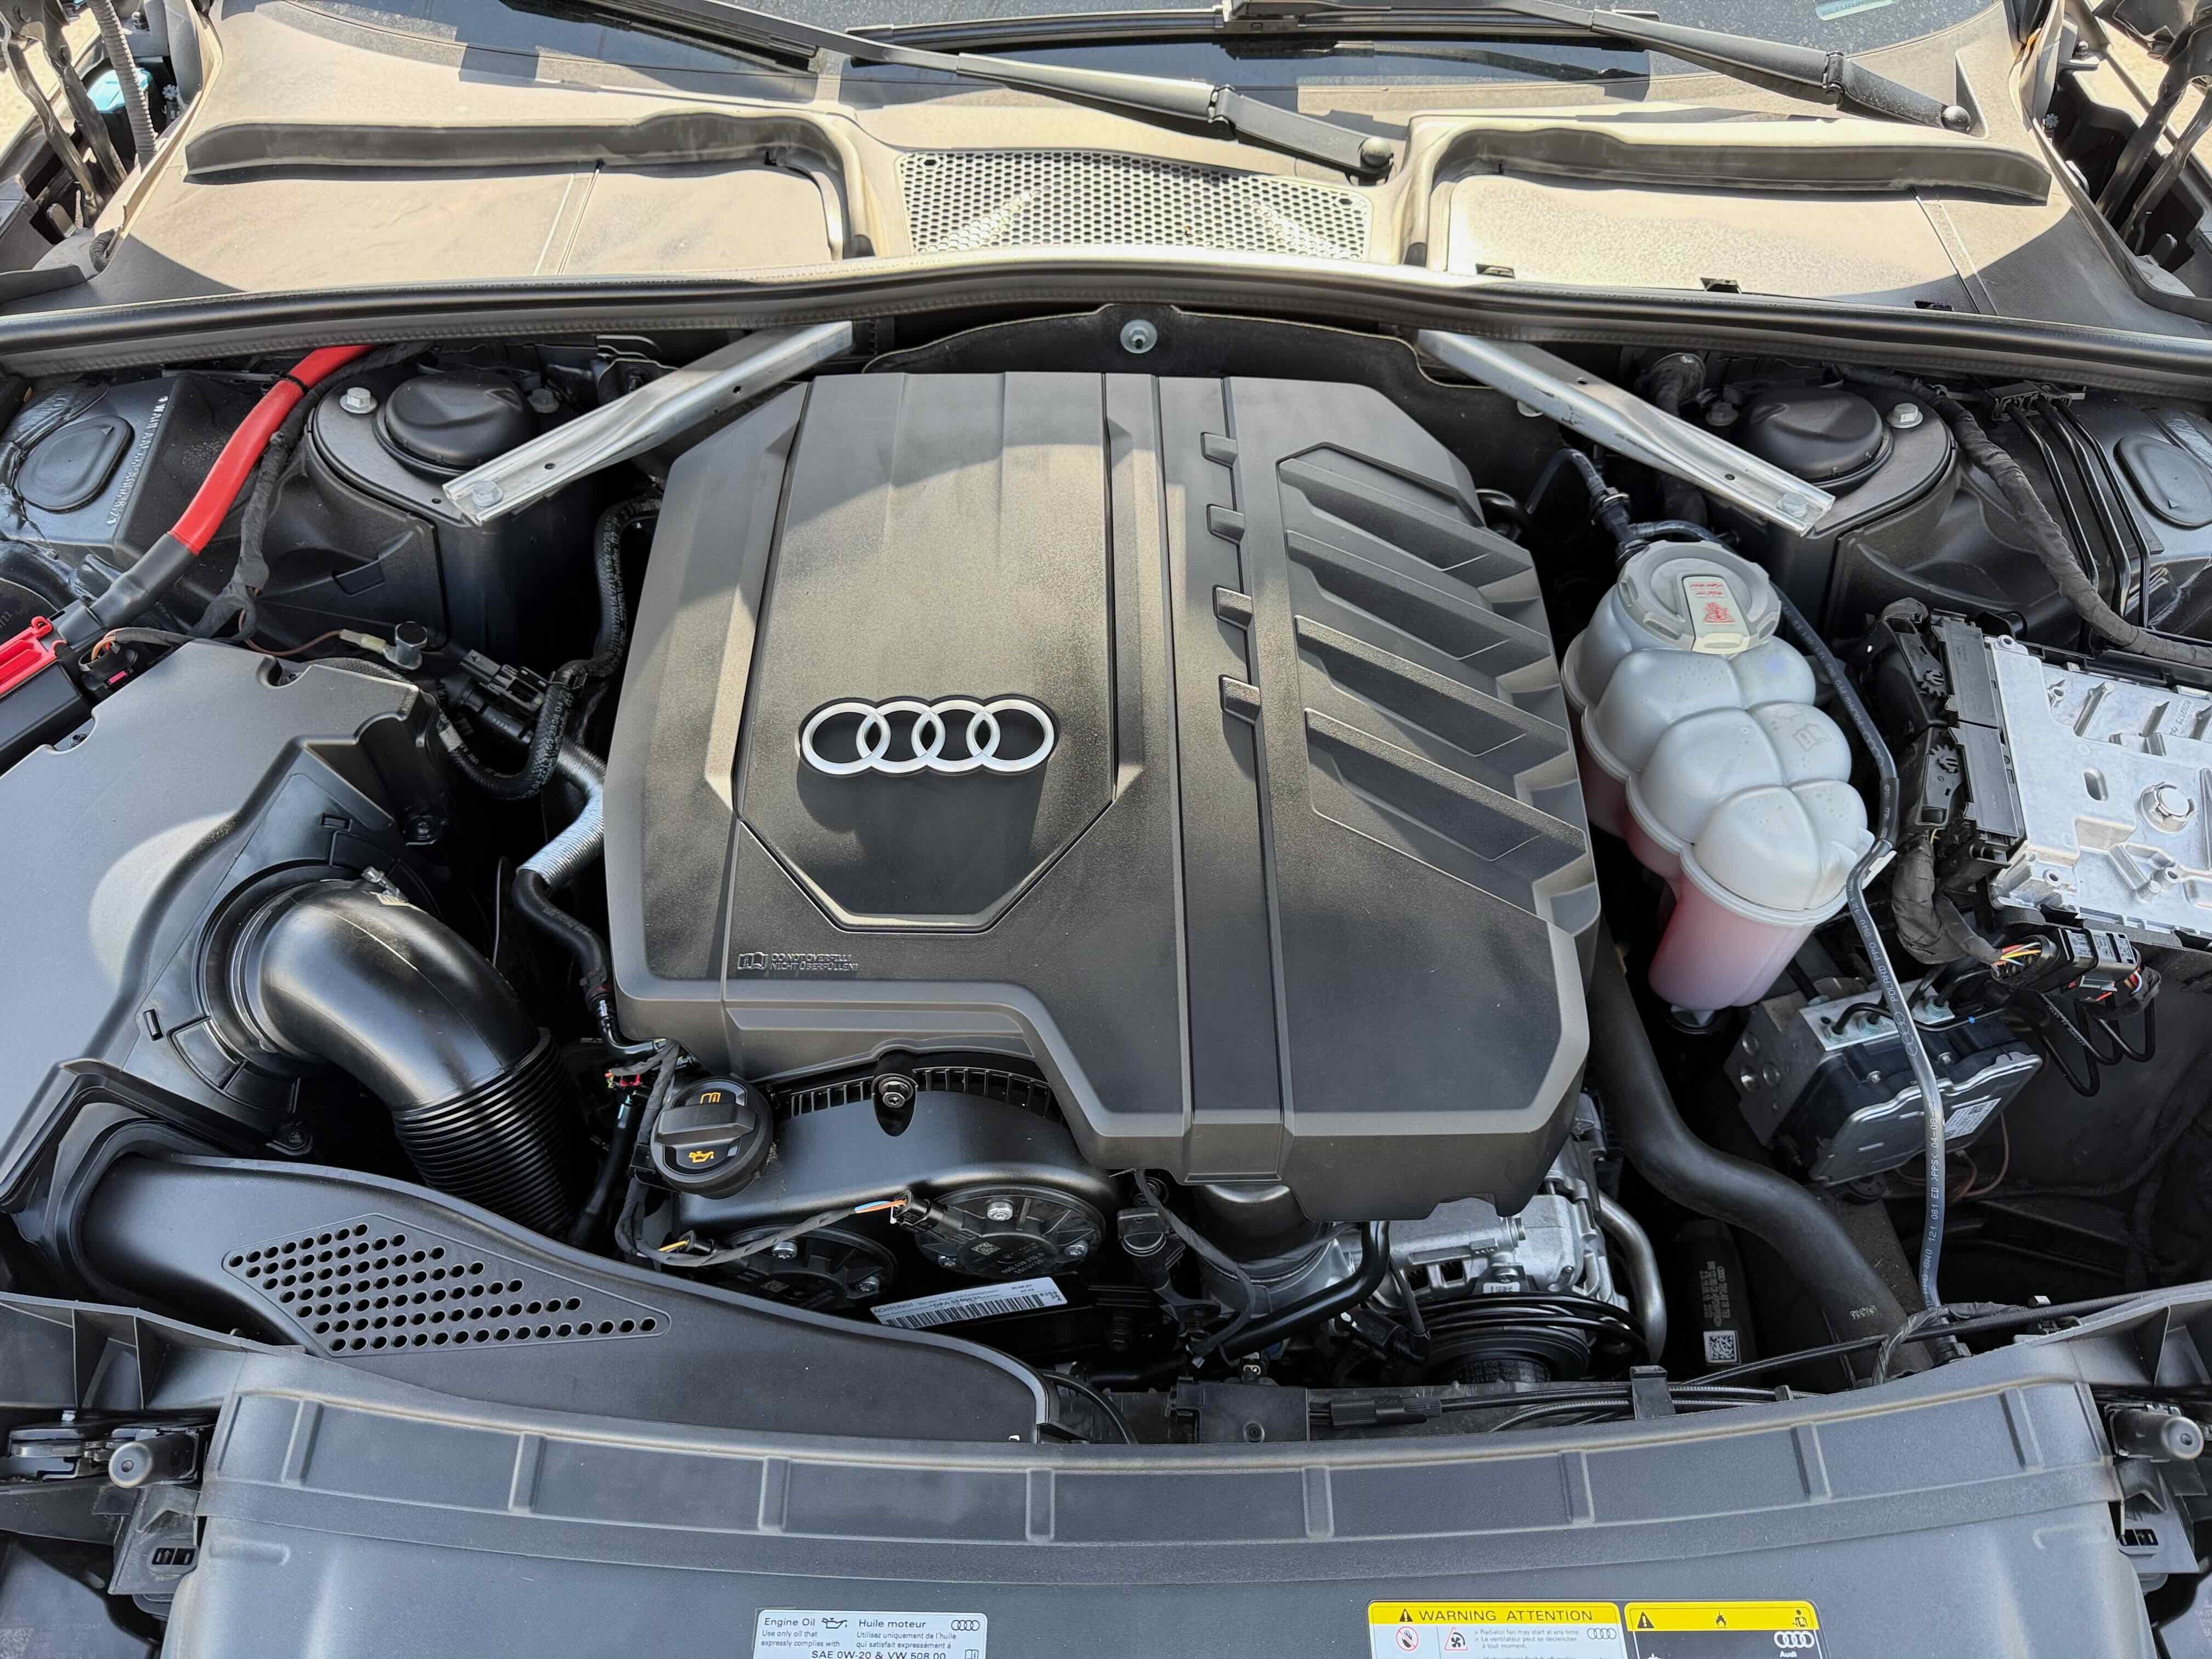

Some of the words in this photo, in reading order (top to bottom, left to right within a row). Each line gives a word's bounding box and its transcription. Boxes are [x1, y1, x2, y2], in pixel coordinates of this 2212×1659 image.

[1870, 941, 1881, 961] PPO
[771, 953, 786, 961] DO
[787, 953, 806, 961] NOT
[770, 962, 798, 970] NICHT
[1878, 965, 1899, 1002] POLAND
[1931, 1186, 1939, 1199] ED
[1931, 1205, 1939, 1220] 081
[1927, 1226, 1937, 1242] 121
[1419, 1610, 1497, 1621] WARNING
[1506, 1610, 1593, 1621] ATTENTION
[764, 1618, 798, 1627] Engine
[802, 1618, 816, 1626] Oil
[859, 1619, 884, 1627] Huile
[888, 1620, 926, 1628] moteur
[811, 1650, 833, 1658] SAE
[837, 1651, 871, 1659] 0W-20
